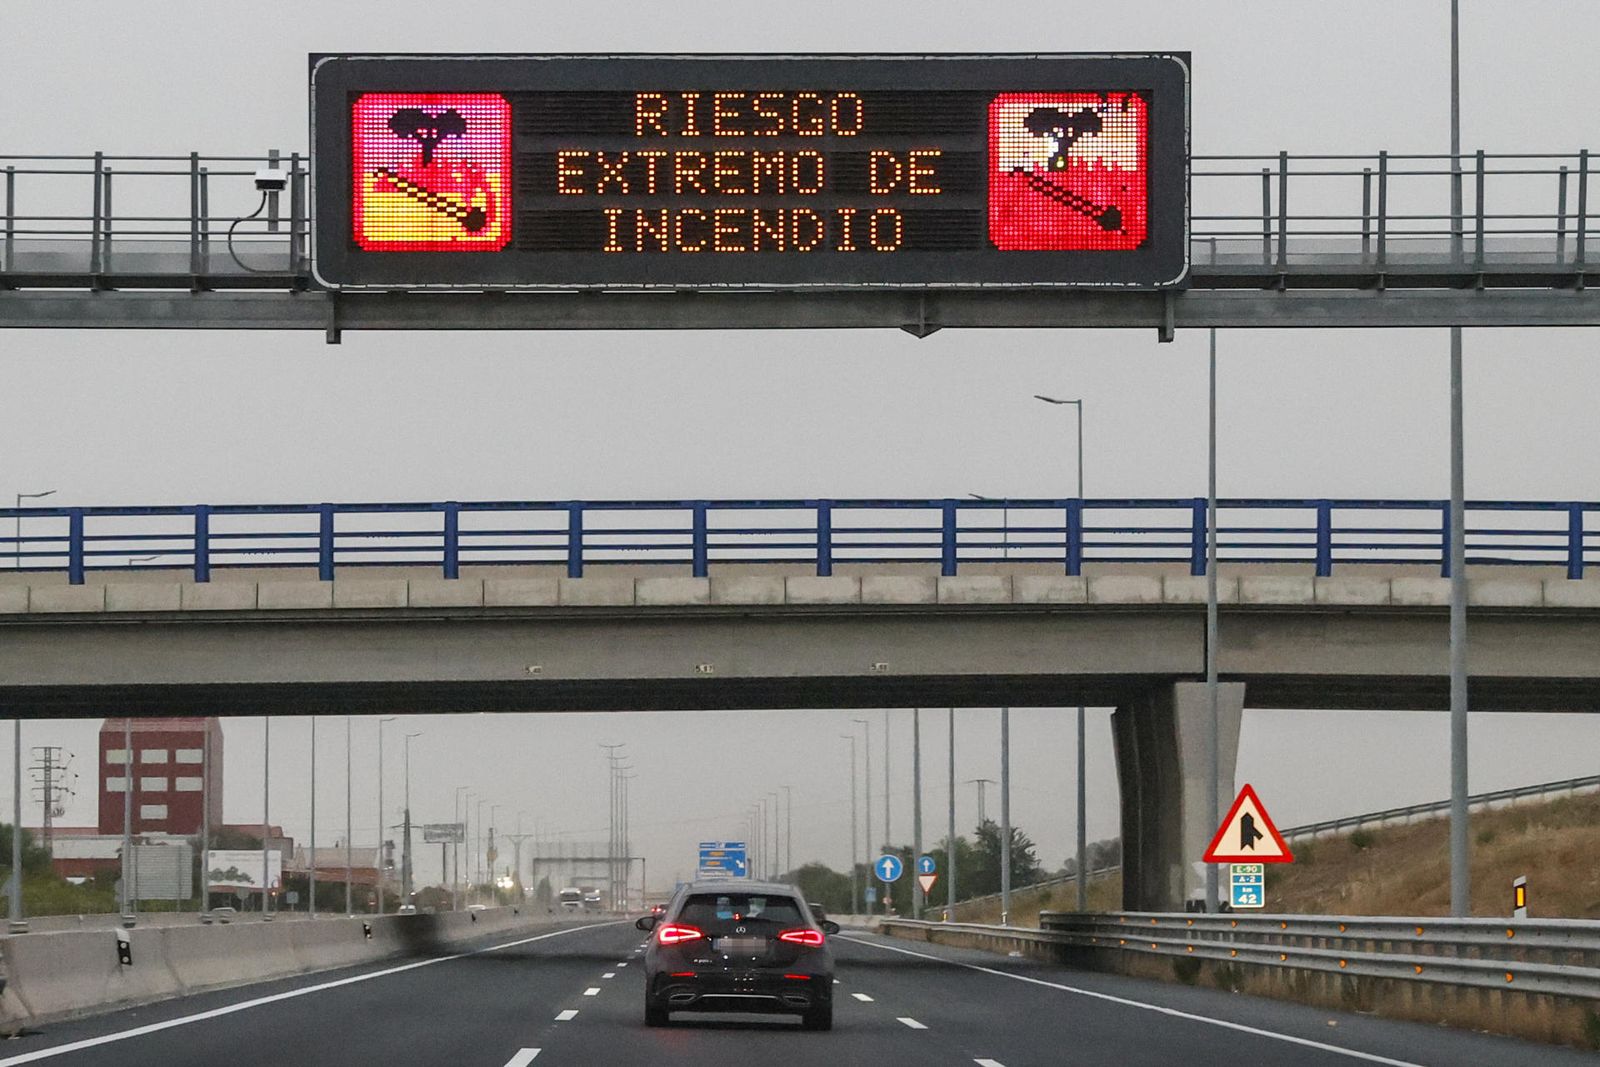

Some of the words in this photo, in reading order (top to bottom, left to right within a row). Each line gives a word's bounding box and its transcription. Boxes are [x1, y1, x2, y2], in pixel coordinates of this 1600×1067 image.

[636, 93, 863, 135] RIESGO
[558, 151, 823, 194] EXTREMO
[870, 151, 941, 194] DE
[604, 208, 902, 252] INCENDIO
[1238, 894, 1257, 904] 42
